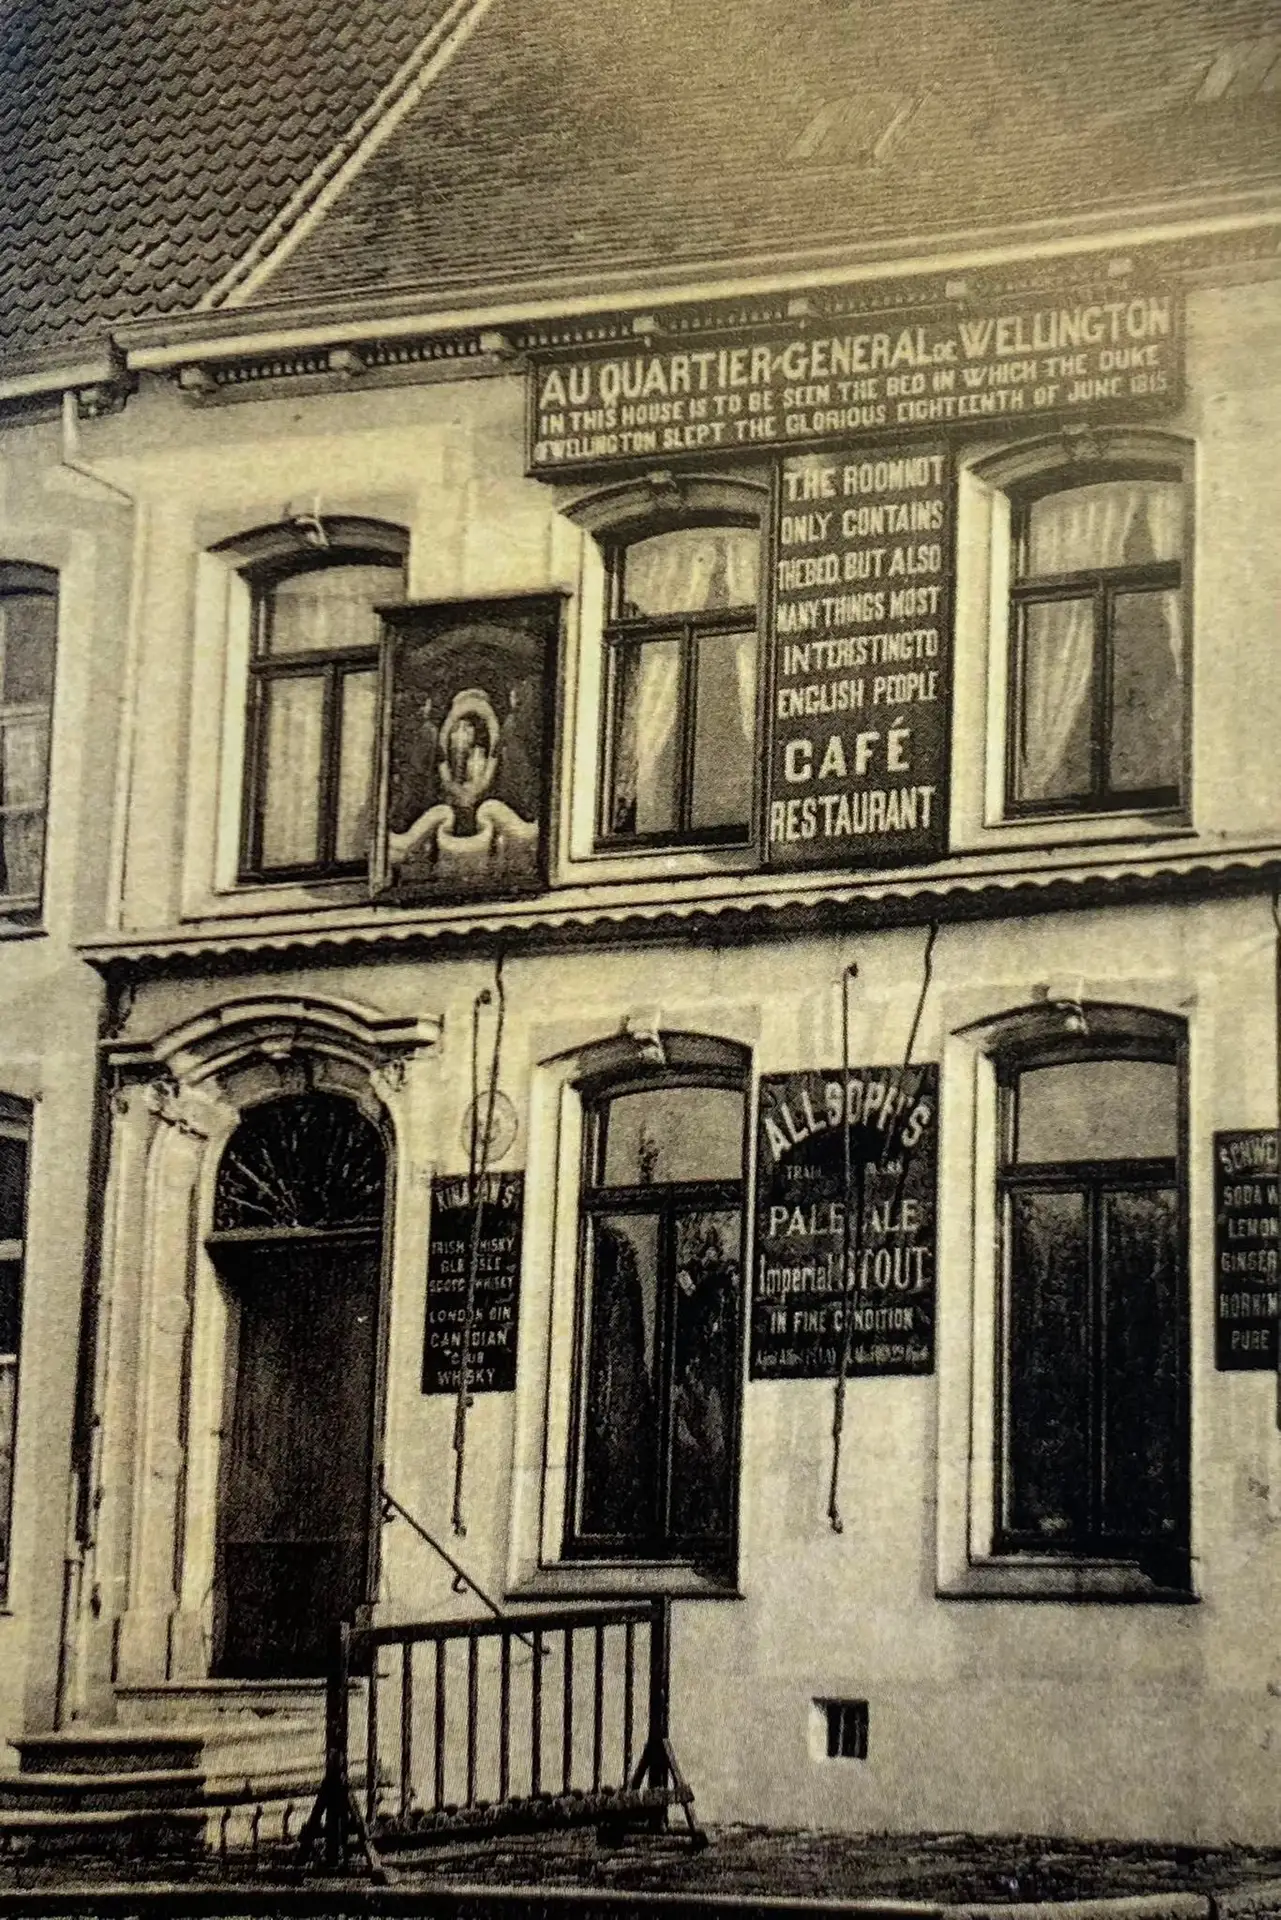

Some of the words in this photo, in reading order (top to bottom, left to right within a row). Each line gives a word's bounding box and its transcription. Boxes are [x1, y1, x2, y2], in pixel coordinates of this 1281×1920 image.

[540, 366, 592, 410] AU
[958, 296, 1170, 359] WELLINGTON
[541, 413, 565, 436] IN
[568, 407, 617, 431] THIS
[622, 400, 685, 426] HOUSE
[690, 398, 707, 419] IS
[714, 395, 741, 416] TO
[750, 390, 774, 413] BE
[783, 384, 831, 410] SEEN
[838, 378, 879, 401] THE
[887, 372, 926, 398] BED
[932, 370, 956, 393] IN
[961, 359, 1038, 388] WHICH
[1041, 353, 1088, 378] THE
[1101, 343, 1160, 371] DUKE
[663, 422, 726, 450] SLEPT
[735, 414, 777, 443] THE
[786, 403, 887, 436] GLORIOUS
[897, 388, 1024, 423] EIGHTEENTH
[1033, 384, 1060, 406] OF
[1067, 376, 1122, 402] JUNE
[783, 466, 837, 501] THE
[781, 510, 833, 545] ONLY
[842, 499, 945, 538] CONTAINS
[844, 548, 887, 581] BUT
[888, 544, 942, 577] ALSO
[777, 600, 819, 632] MANY
[822, 591, 885, 629] THINGS
[890, 585, 942, 620] MOST
[778, 677, 865, 720] ENGLISH
[873, 669, 940, 706] PEOPLE
[784, 715, 911, 784] CAFÉ
[770, 785, 937, 843] RESTAURANT
[1223, 1183, 1263, 1206] SODA
[769, 1202, 847, 1240] PALE
[862, 1198, 921, 1234] ALE
[1227, 1216, 1280, 1239] LEMON
[758, 1252, 833, 1305] Imperial
[1221, 1248, 1278, 1273] GINGER
[430, 1328, 509, 1349] CANDIAN
[770, 1310, 788, 1335] IN
[792, 1308, 828, 1334] FINE
[1231, 1328, 1271, 1351] PURE
